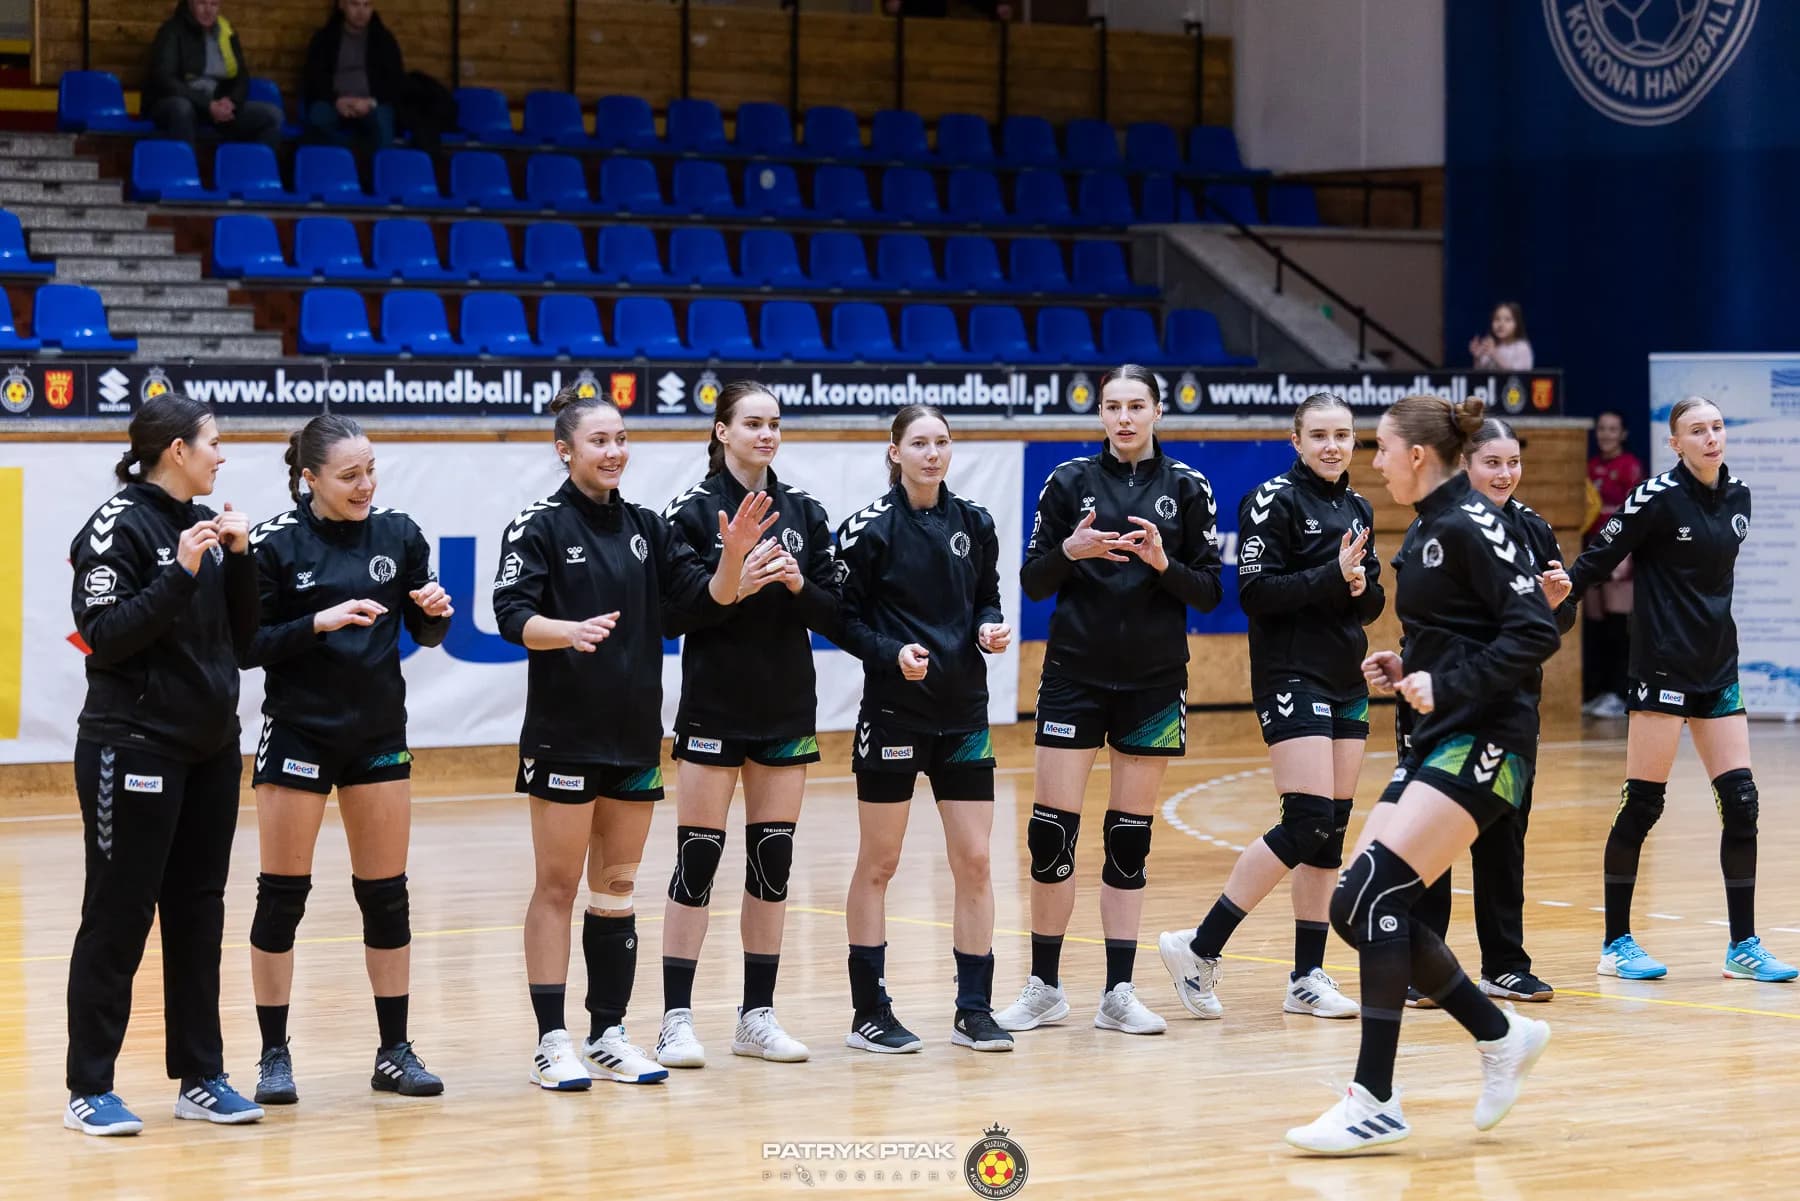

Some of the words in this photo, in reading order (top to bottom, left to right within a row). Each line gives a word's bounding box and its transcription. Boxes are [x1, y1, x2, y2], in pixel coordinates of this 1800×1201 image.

[1565, 3, 1638, 98] KORONA
[184, 368, 562, 414] www.koronahandball.pl
[766, 372, 1059, 415] w.koronahandball.pl
[1045, 723, 1072, 735] Meest
[691, 739, 718, 750] Meest
[884, 748, 911, 758] Meest
[287, 761, 314, 775] Meest
[128, 778, 158, 789] Meest
[552, 776, 580, 787] Meest
